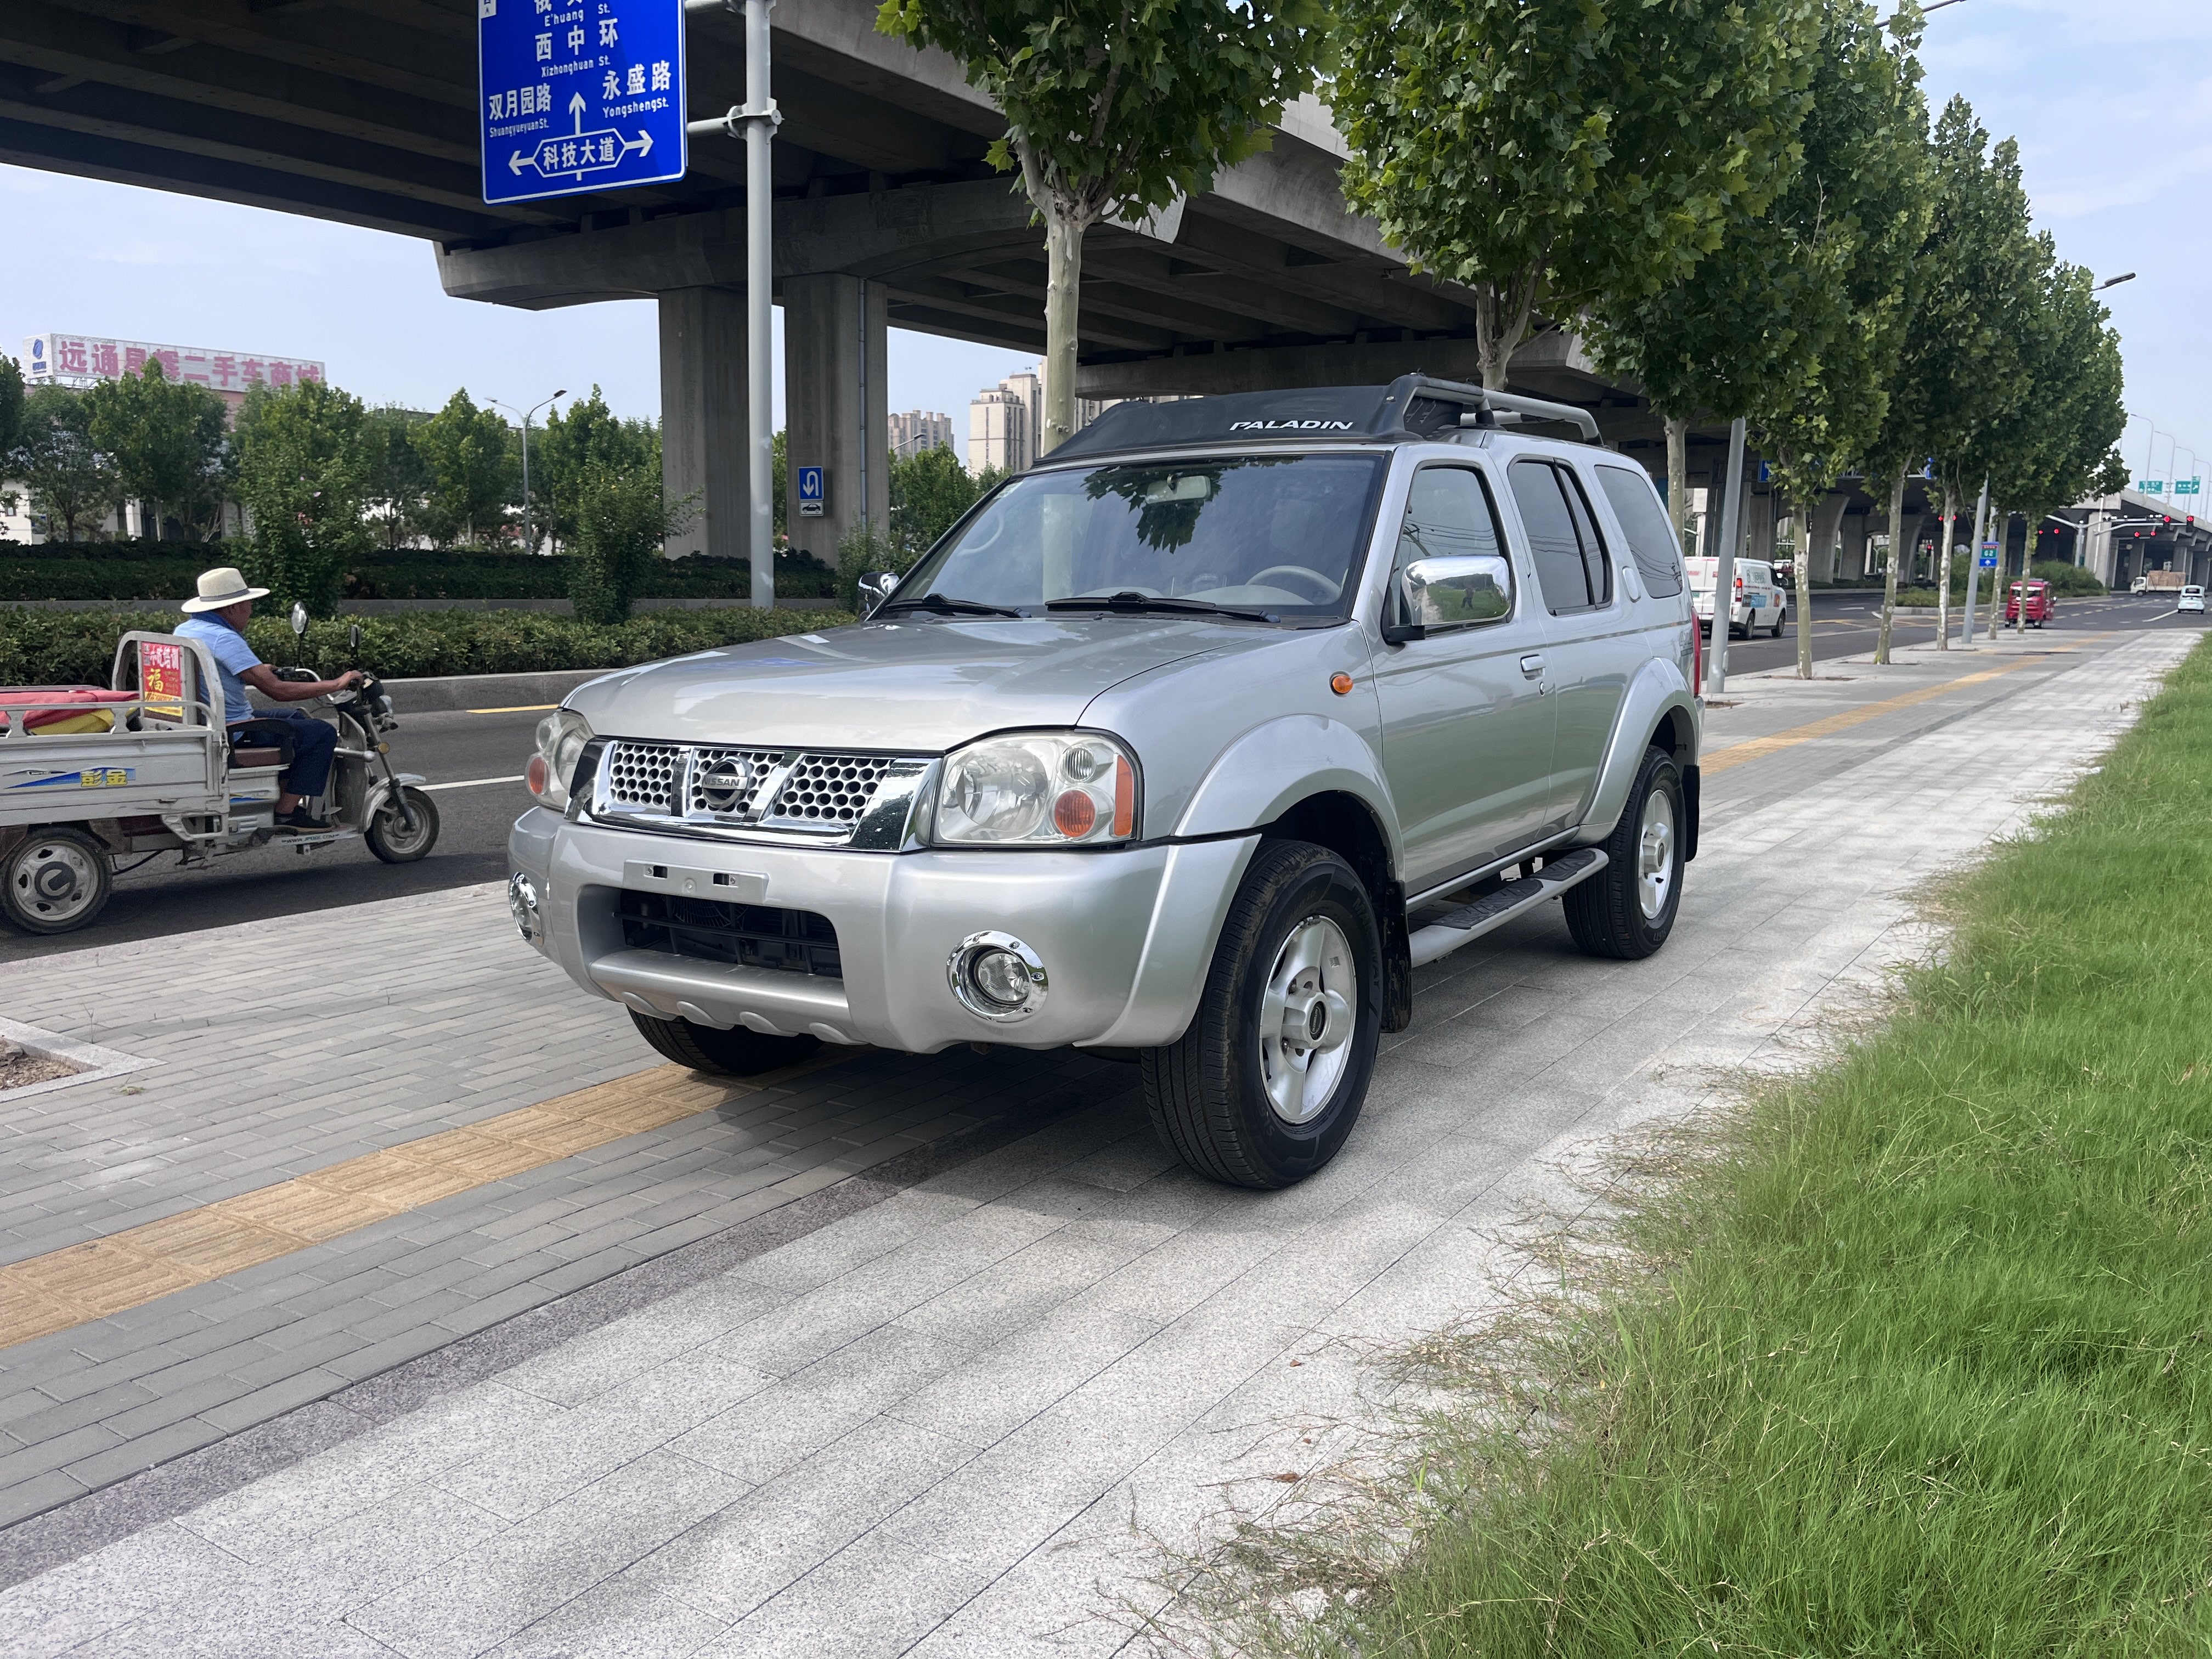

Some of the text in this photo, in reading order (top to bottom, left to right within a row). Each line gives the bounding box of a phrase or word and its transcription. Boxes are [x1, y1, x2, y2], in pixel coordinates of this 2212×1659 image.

[598, 3, 611, 14] St.
[535, 18, 619, 62] 西中环
[598, 55, 611, 66] St.
[602, 60, 672, 100] 永盛路
[489, 82, 552, 121] 双月园路
[543, 136, 616, 171] 科技大道
[1229, 420, 1353, 431] PALADIN
[145, 668, 164, 692] 福
[702, 777, 740, 786] NISSAN
